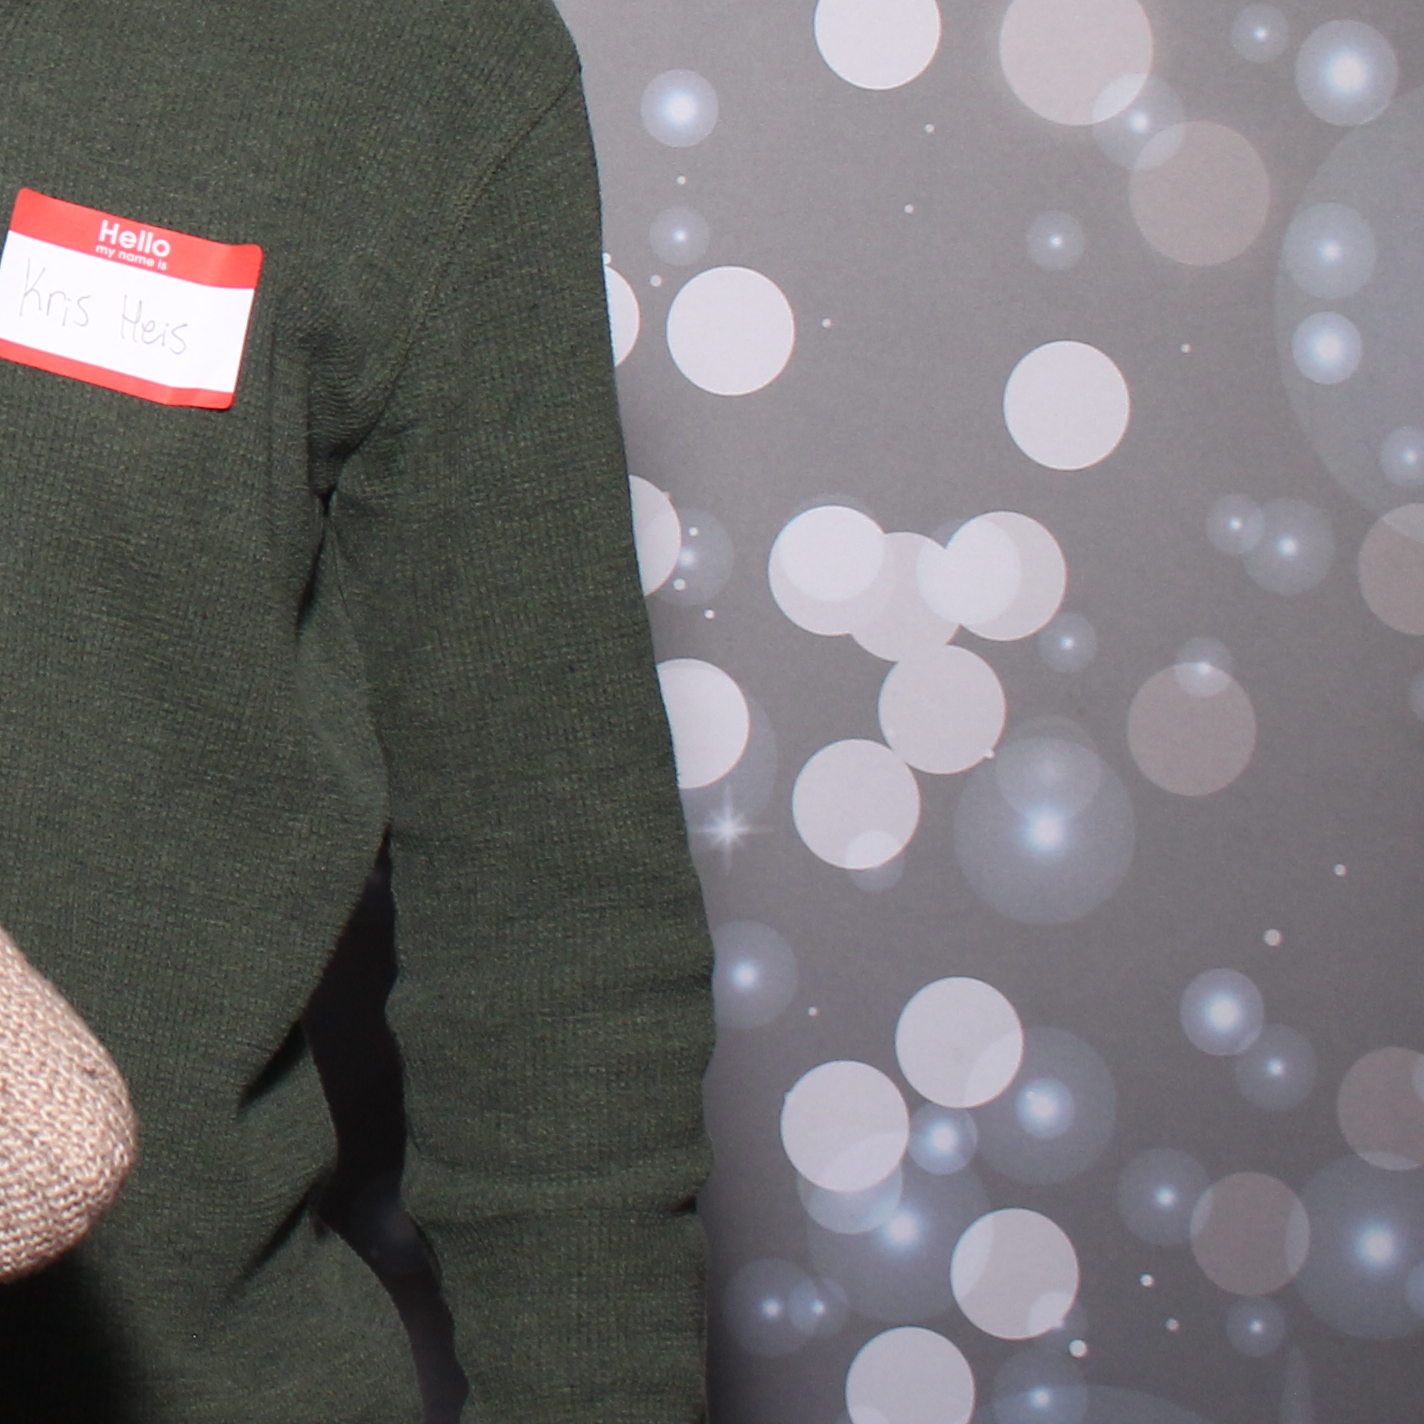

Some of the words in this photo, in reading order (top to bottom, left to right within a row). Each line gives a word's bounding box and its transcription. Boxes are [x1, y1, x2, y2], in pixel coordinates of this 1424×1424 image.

[95, 244, 116, 258] my
[118, 250, 155, 267] name
[157, 258, 168, 271] is
[98, 219, 171, 258] Hello
[18, 257, 92, 327] Kris
